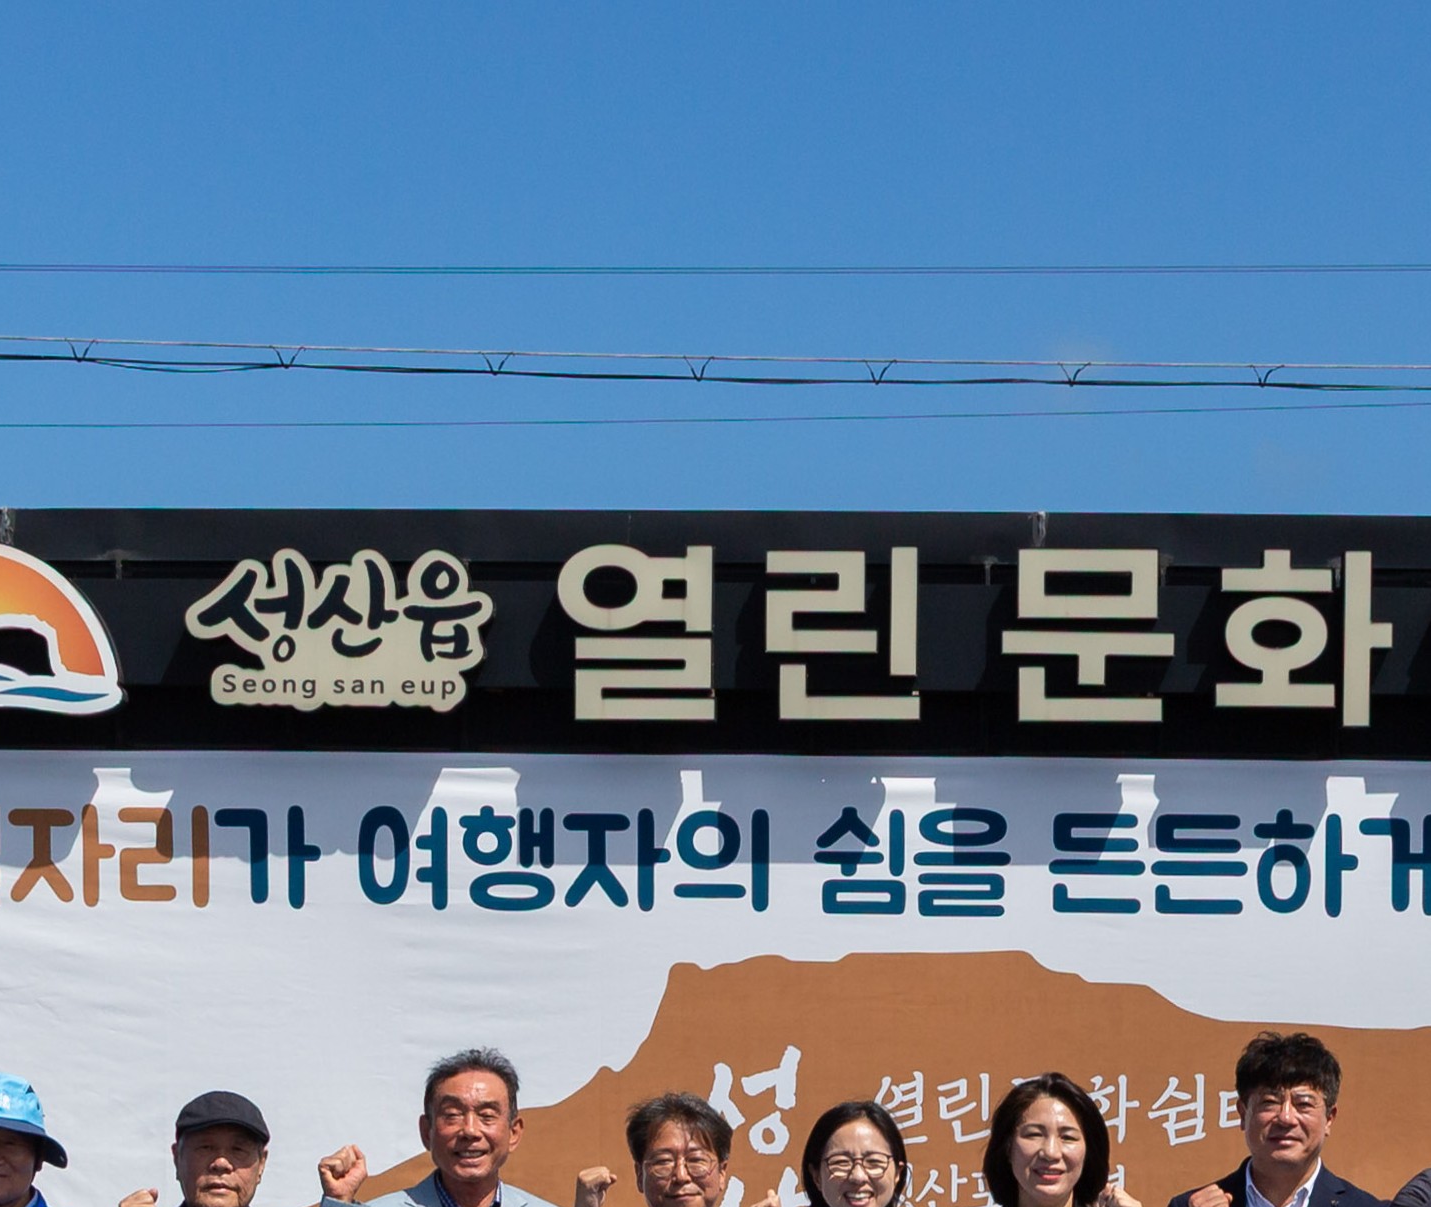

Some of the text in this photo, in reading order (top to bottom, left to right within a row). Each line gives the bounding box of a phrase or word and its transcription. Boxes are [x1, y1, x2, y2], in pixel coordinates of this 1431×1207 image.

[197, 558, 483, 662] 성산읍
[557, 543, 921, 721] 열린
[222, 673, 457, 700] Seong san eup
[357, 803, 770, 912] 여행자의
[813, 806, 1012, 917] 쉼을
[874, 1071, 992, 1143] 열린
